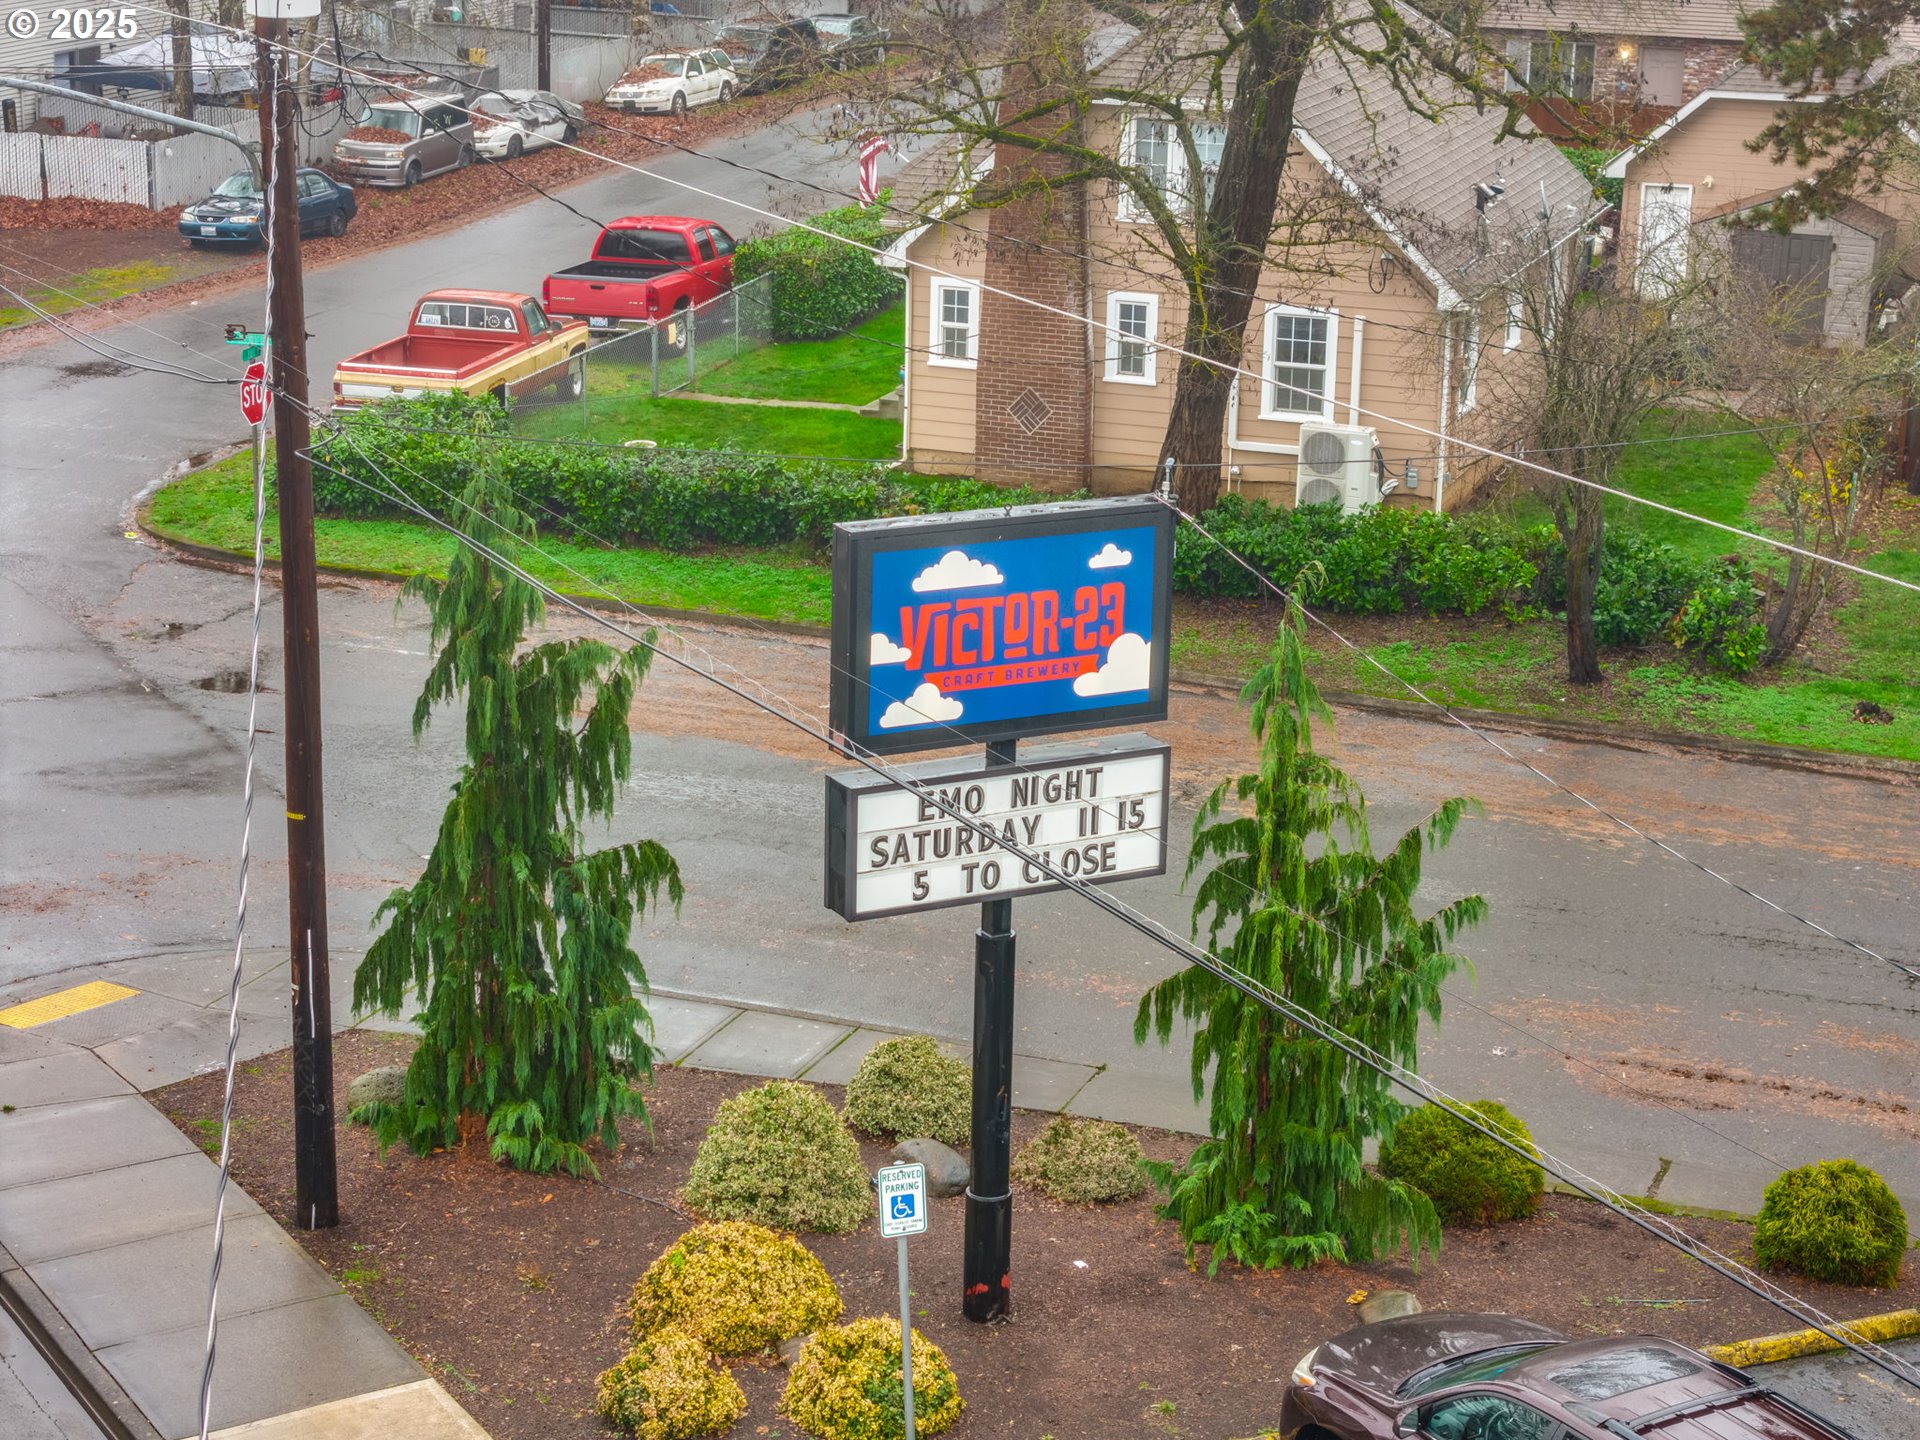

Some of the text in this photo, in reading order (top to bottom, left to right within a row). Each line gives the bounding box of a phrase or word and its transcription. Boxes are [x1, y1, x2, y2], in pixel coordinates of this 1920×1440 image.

[900, 582, 1125, 670] VICTOR-23
[943, 662, 1081, 688] CRAFT BREWERY
[918, 767, 1104, 822] EMO NIGHT
[870, 814, 1042, 868] SATURDAY
[1118, 799, 1145, 832] 15
[912, 841, 1116, 901] 5 TO CLOSE
[882, 1170, 921, 1182] RESERVED
[885, 1182, 919, 1193] PARKING
